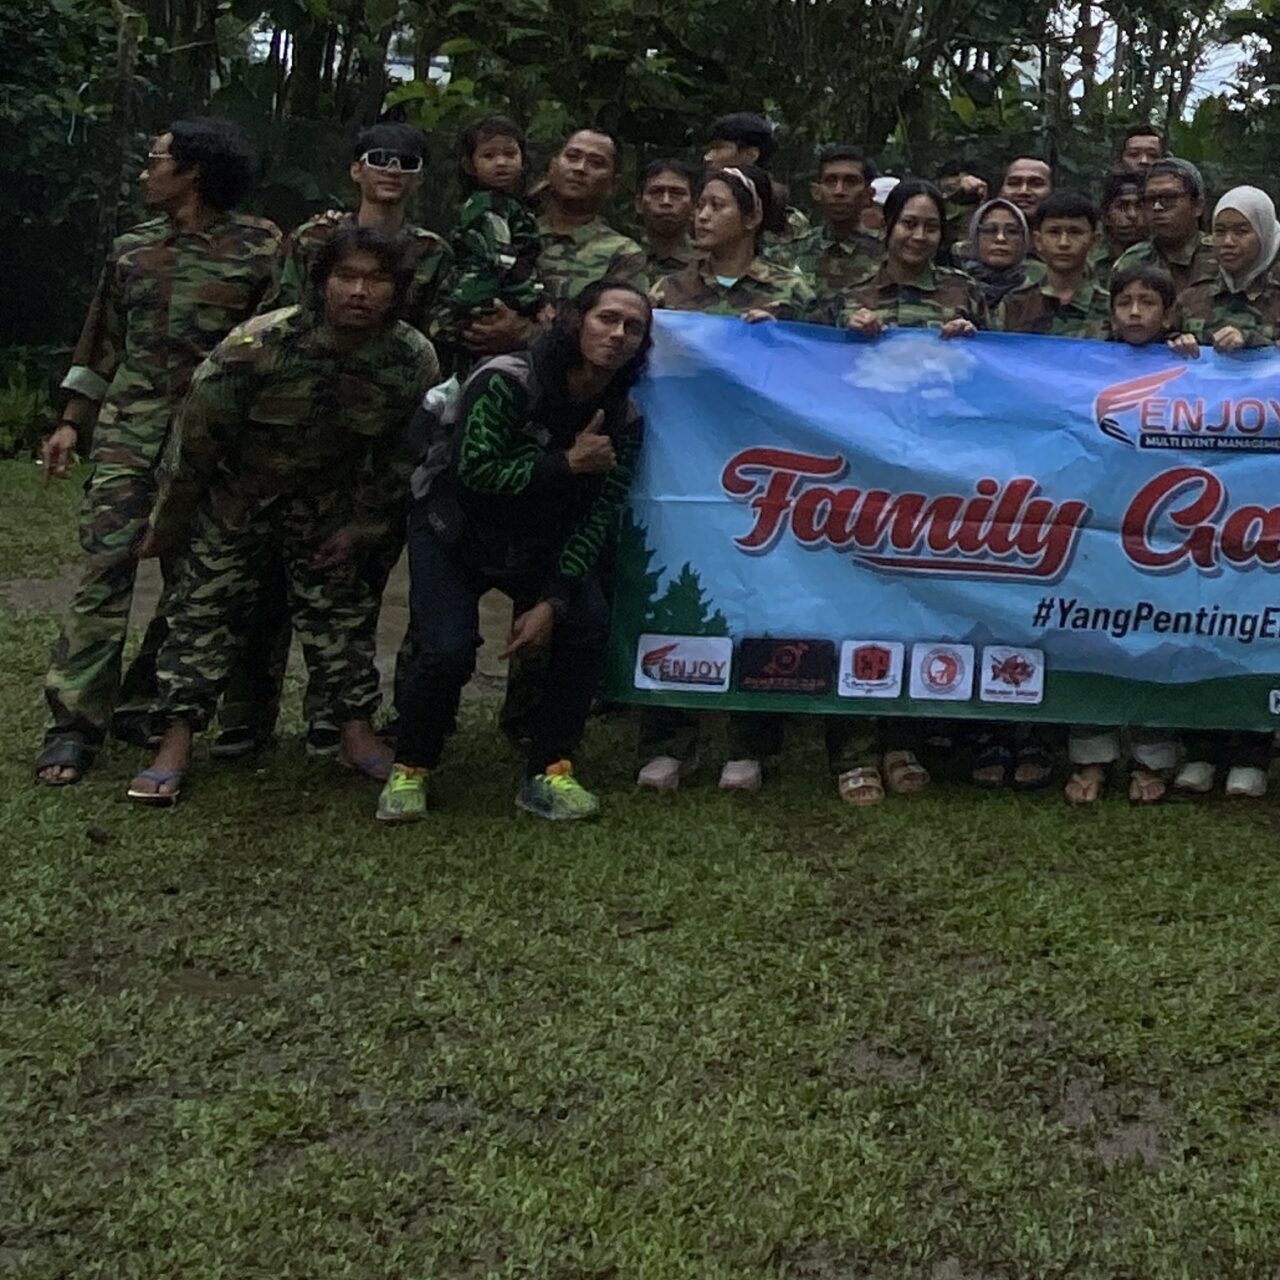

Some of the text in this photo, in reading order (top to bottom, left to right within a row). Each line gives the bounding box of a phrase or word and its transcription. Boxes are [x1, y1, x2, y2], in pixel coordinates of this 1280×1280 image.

[1145, 436, 1181, 447] MULTI
[1181, 437, 1215, 448] EVENT
[720, 446, 1091, 583] Family
[660, 657, 727, 678] ENJOY
